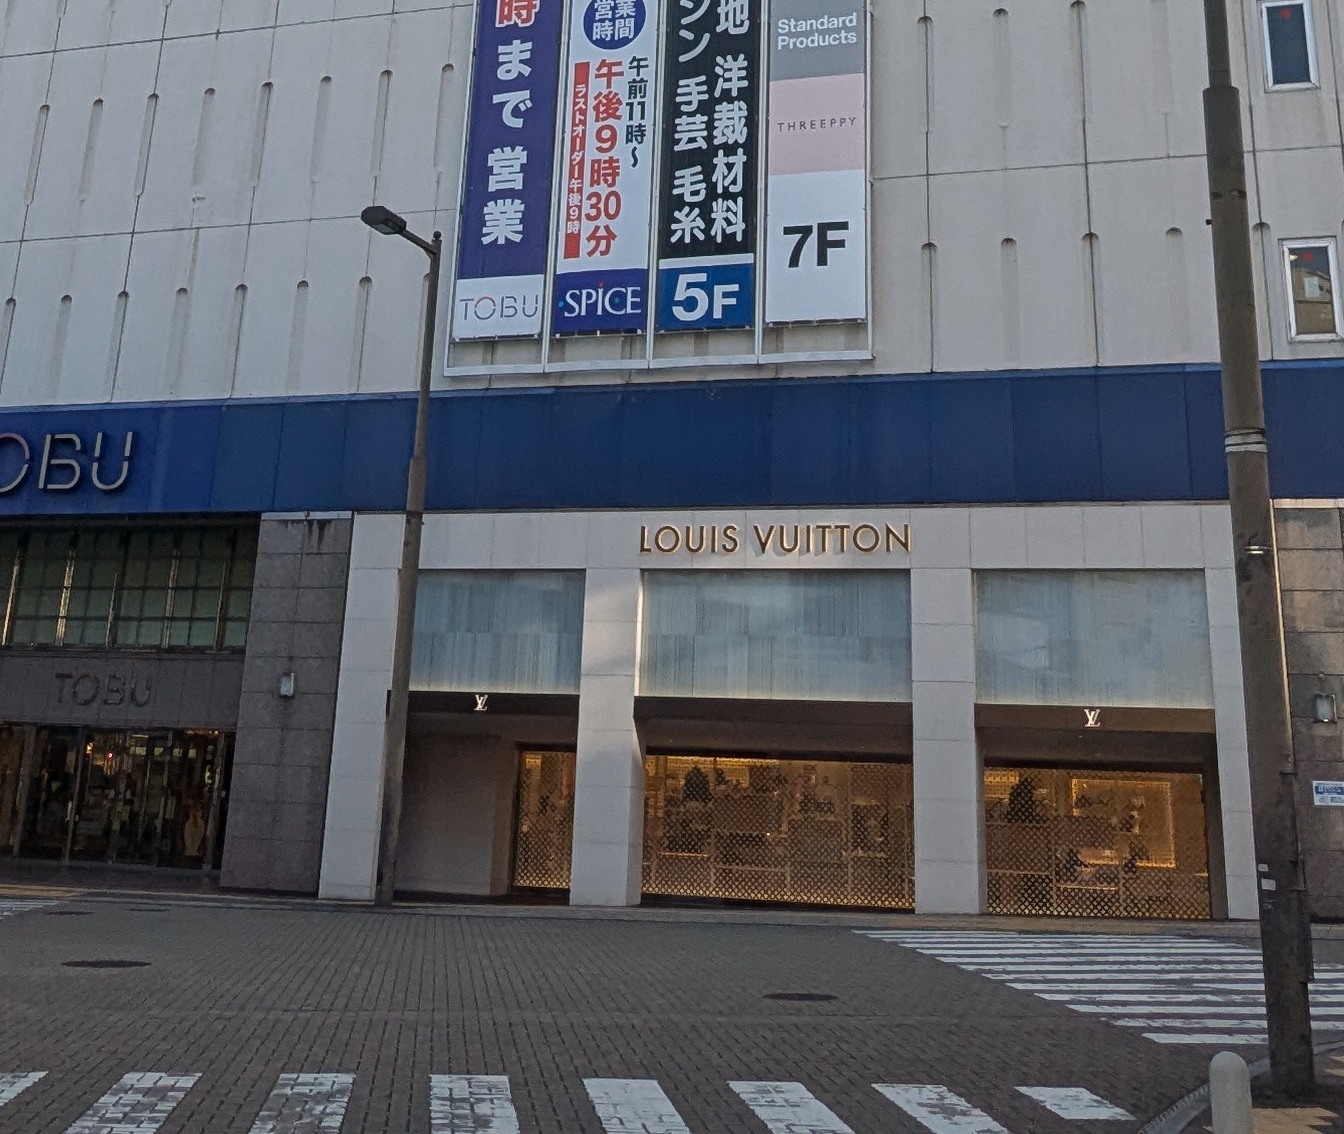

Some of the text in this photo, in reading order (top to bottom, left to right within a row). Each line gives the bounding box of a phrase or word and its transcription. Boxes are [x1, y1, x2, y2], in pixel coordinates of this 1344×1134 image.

[592, 19, 635, 42] 時間
[777, 11, 857, 33] Standard
[777, 29, 857, 51] Products
[674, 75, 709, 152] 手芸
[777, 116, 857, 132] THREEPPY
[567, 84, 587, 234] ラストオーダー午後9時
[584, 58, 624, 258] 午後9時30分
[711, 54, 750, 245] 洋裁材料
[670, 166, 707, 245] 毛糸
[782, 221, 850, 268] 7F
[459, 294, 539, 322] TOBU
[563, 282, 642, 318] SPICE
[672, 273, 741, 322] 5F
[640, 522, 912, 555] LOUIS VUITTON
[55, 673, 152, 708] TOBU
